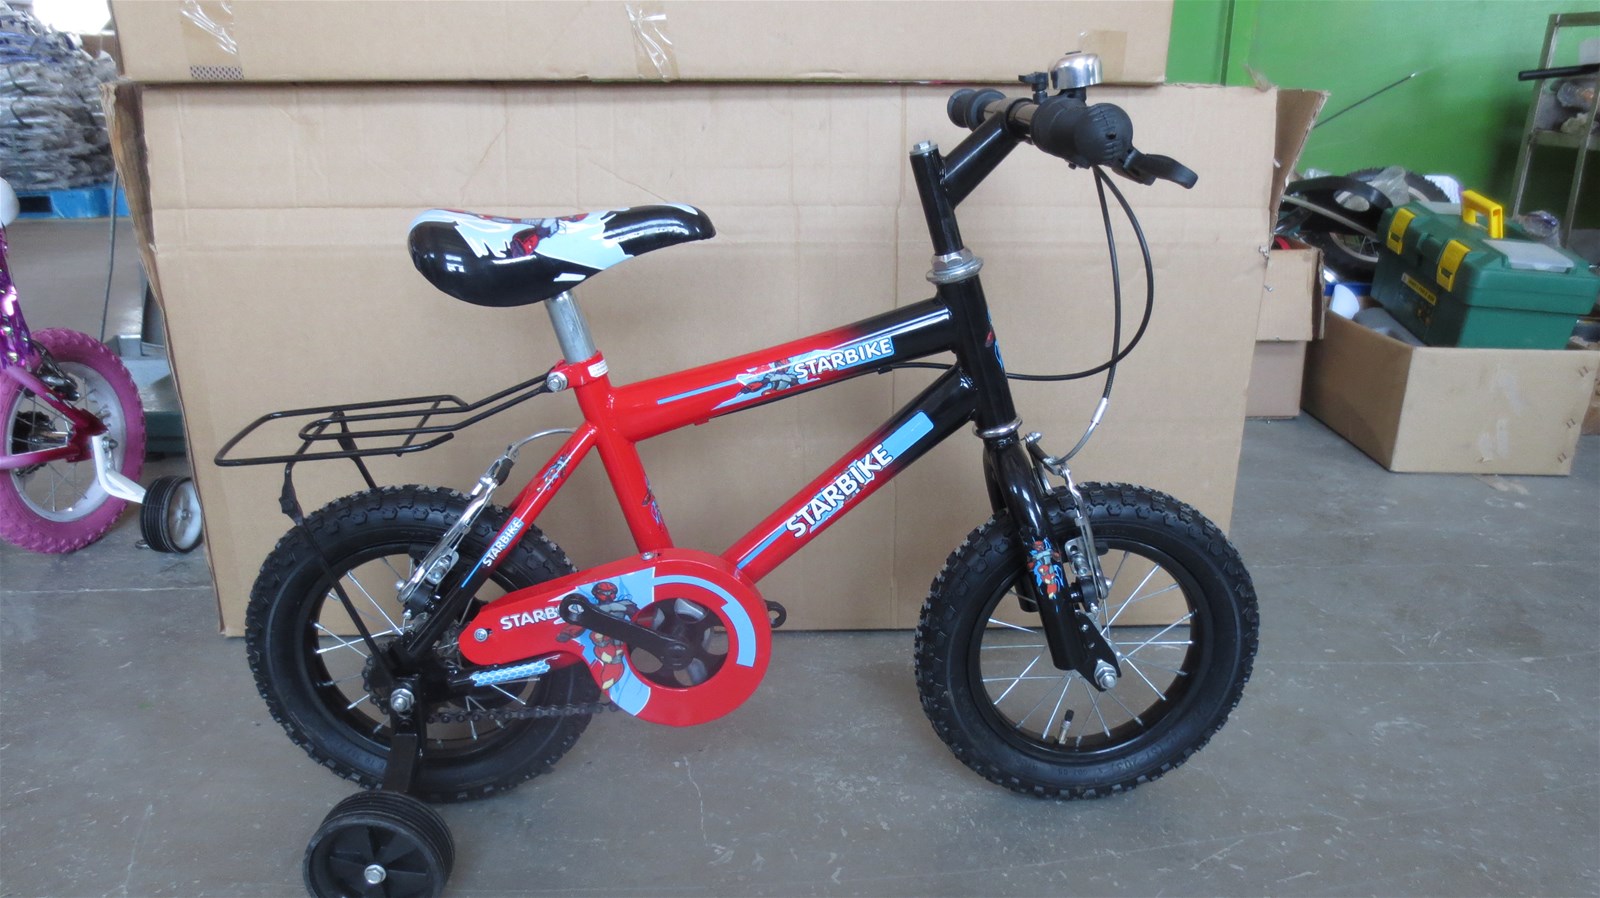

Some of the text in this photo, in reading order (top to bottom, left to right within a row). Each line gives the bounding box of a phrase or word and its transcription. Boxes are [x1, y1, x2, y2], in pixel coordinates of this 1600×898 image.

[794, 338, 892, 379] STARBIKE
[785, 443, 893, 538] STARBIKE
[482, 519, 522, 567] STARBIKE
[500, 604, 560, 630] STARB
